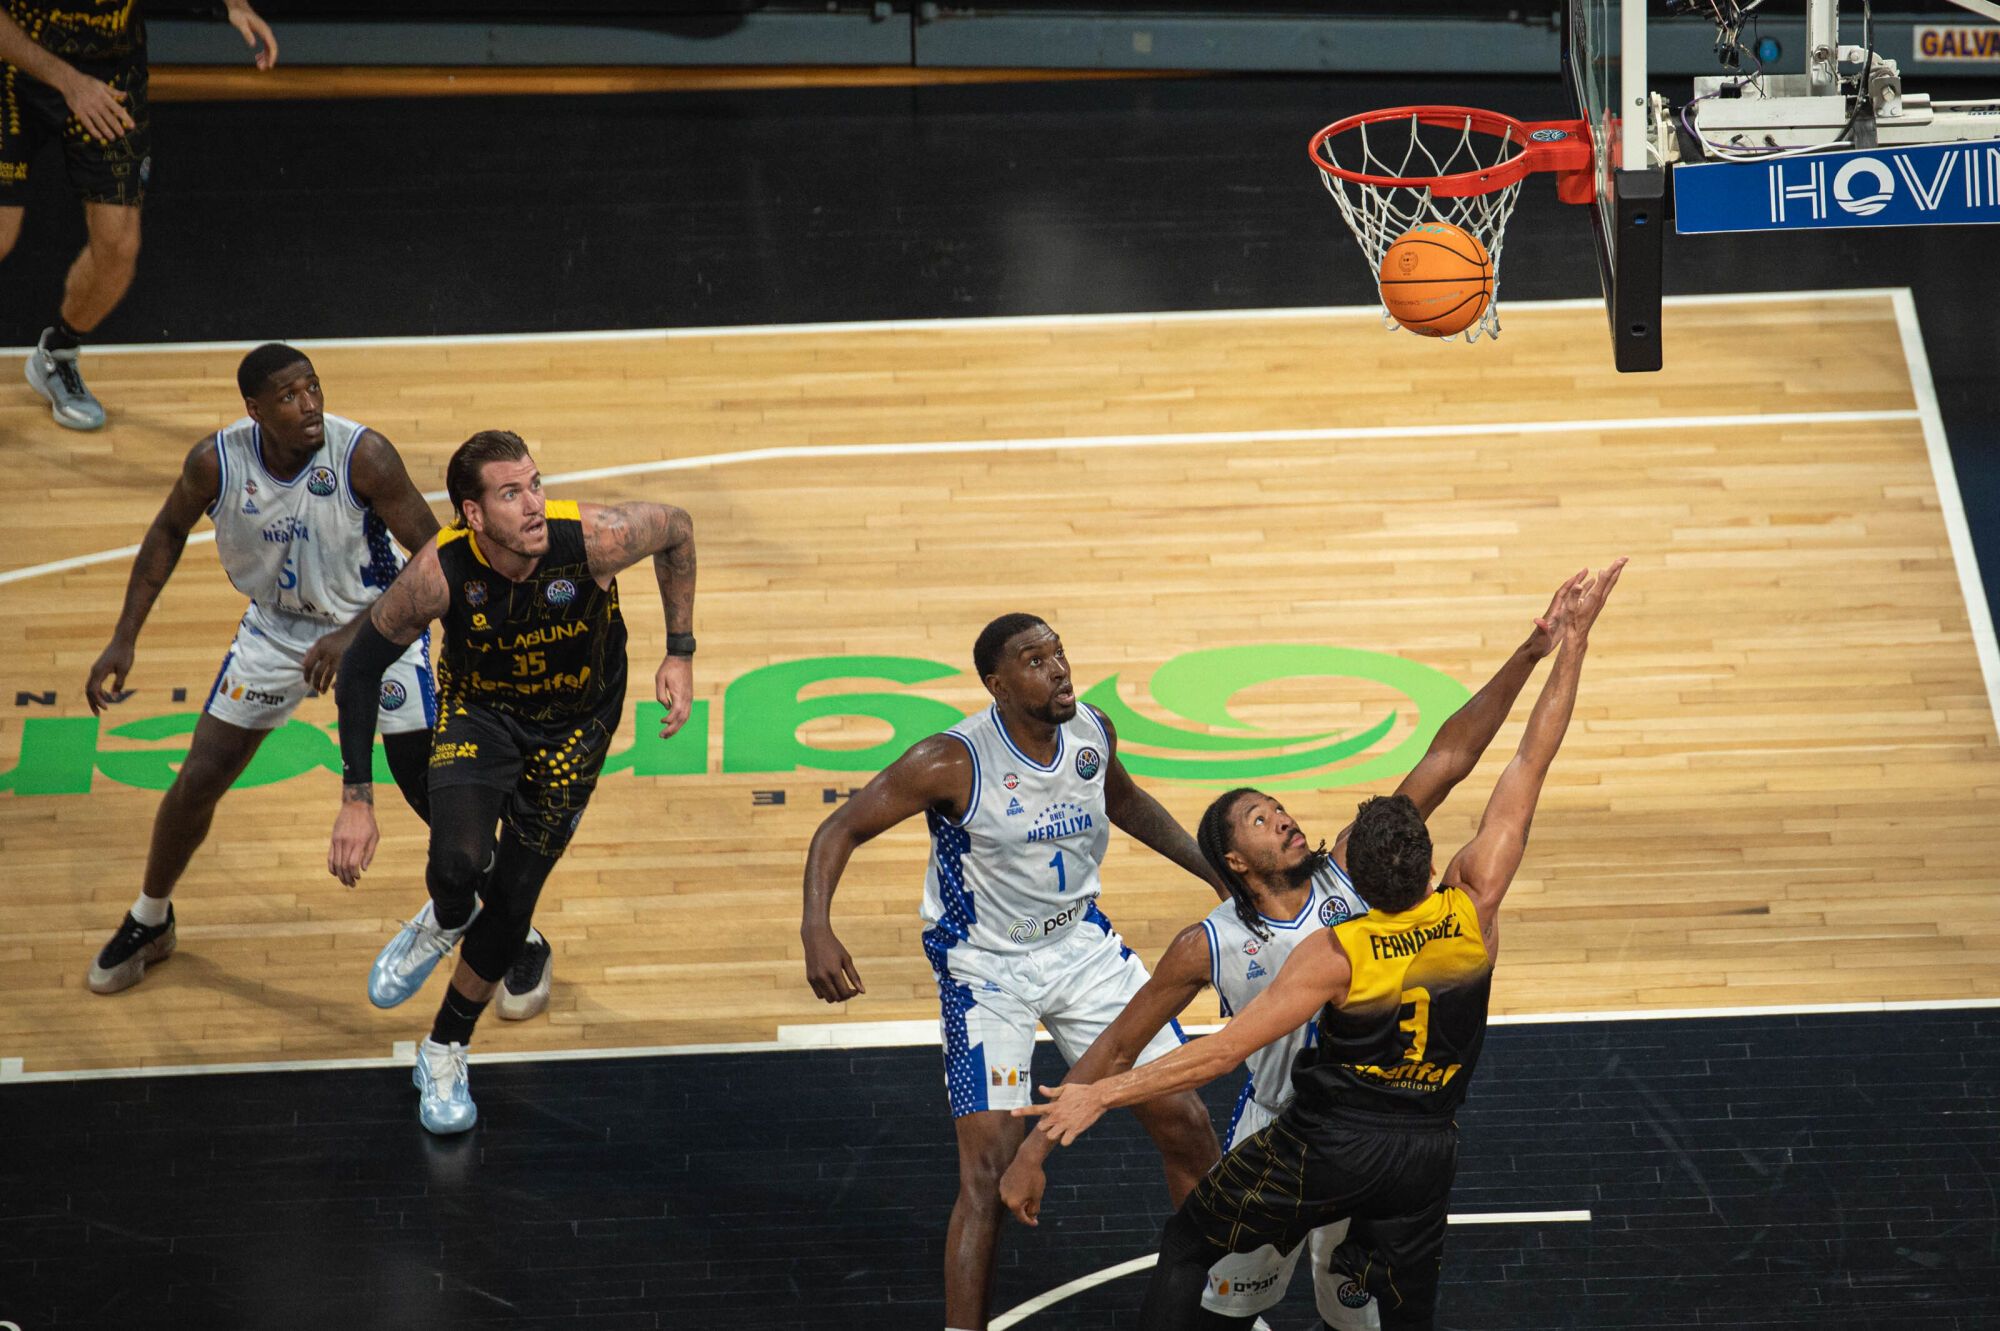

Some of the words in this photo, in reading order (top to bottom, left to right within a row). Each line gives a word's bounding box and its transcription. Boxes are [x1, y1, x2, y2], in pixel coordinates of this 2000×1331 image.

[498, 620, 589, 650] LAGUNA
[511, 651, 546, 677] 35
[1027, 813, 1093, 843] HERZLIYA
[1050, 810, 1065, 822] BNEI
[1049, 850, 1066, 893] 1
[1400, 986, 1430, 1062] 3
